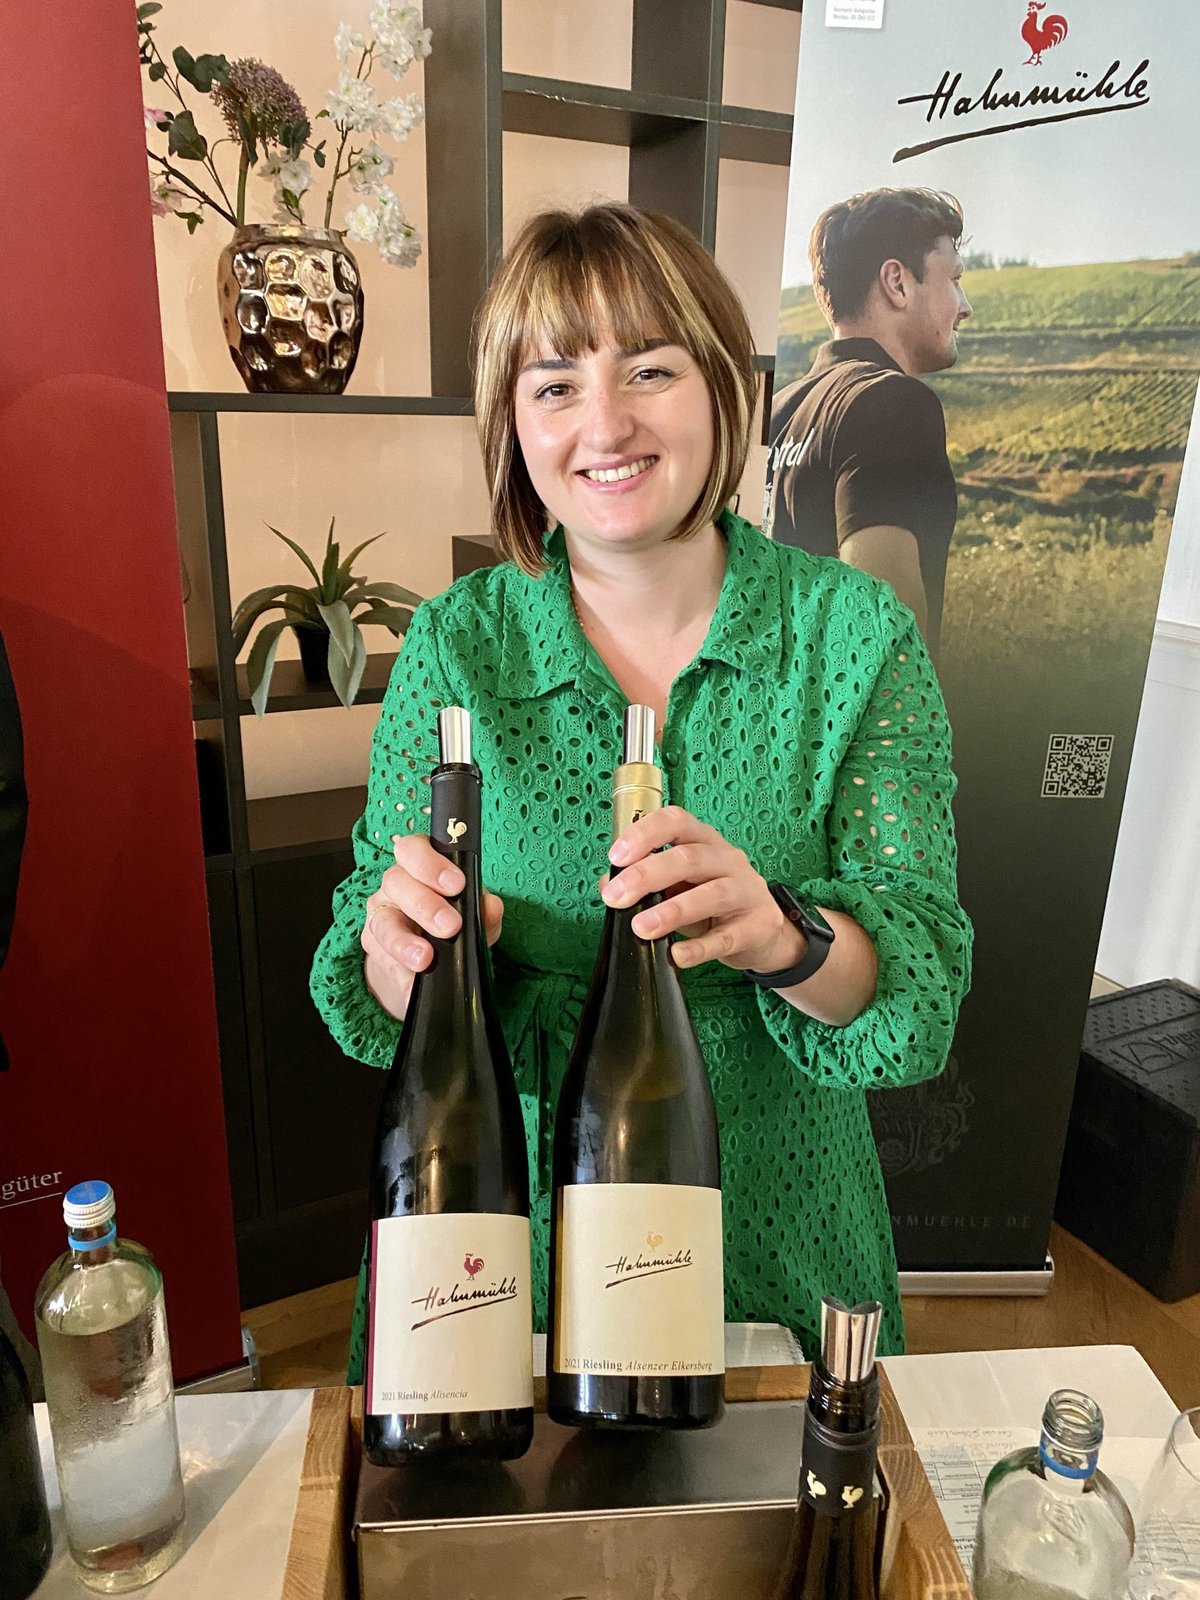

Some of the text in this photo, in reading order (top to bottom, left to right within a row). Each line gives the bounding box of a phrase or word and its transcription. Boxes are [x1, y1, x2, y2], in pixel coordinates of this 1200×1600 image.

[898, 59, 1149, 122] Hahnmühle
[0, 1171, 62, 1200] güter
[605, 1250, 693, 1274] Hahnmühle
[411, 1277, 518, 1310] Hahnmühle
[563, 1358, 713, 1372] 2021 Riesling Alsenzer Elkersberg
[381, 1389, 468, 1402] 2021 Riesling Alisencia
